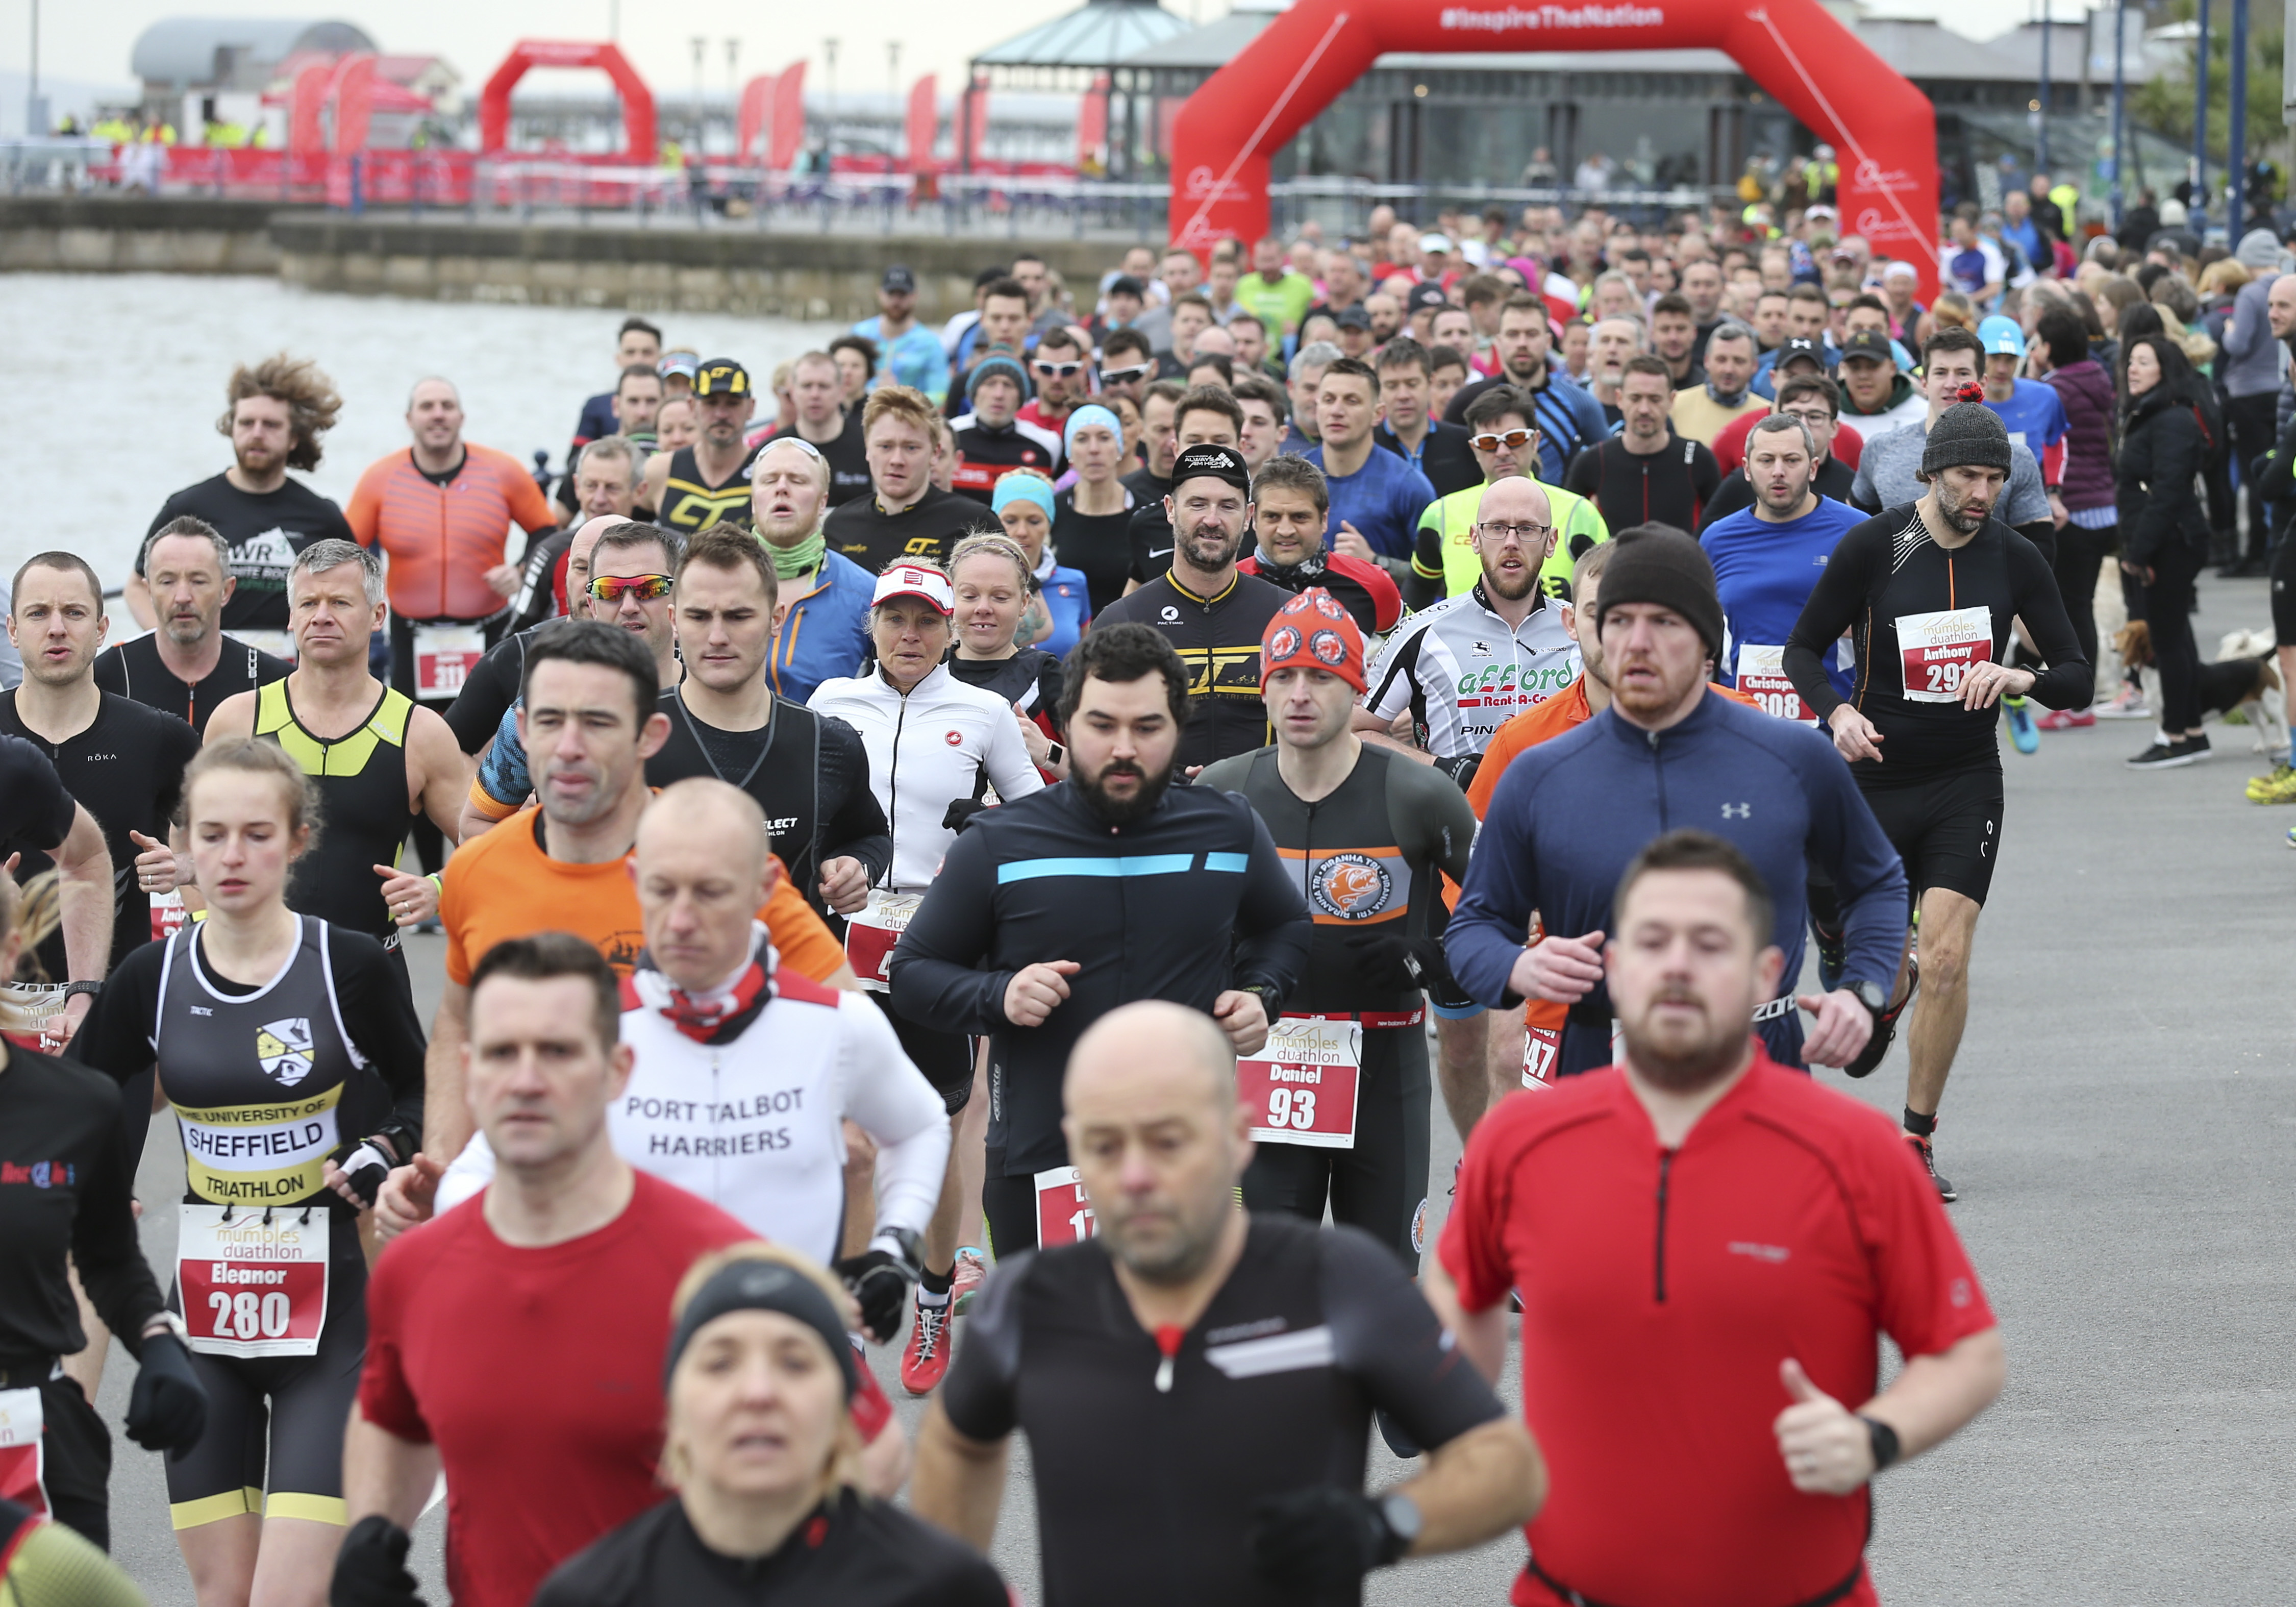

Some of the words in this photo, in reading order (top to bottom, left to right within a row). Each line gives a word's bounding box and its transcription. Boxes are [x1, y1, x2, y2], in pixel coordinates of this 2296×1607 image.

[1440, 3, 1664, 33] #InspireTheNation
[230, 565, 261, 579] HITE
[1923, 616, 1976, 636] mumbles
[1930, 630, 1978, 645] duathlon
[1924, 645, 1973, 662] Anthony
[372, 721, 401, 741] 2XU
[1320, 854, 1364, 872] PIRANHA
[1365, 858, 1381, 871] TRI
[1271, 1029, 1338, 1050] mumbles
[1277, 1048, 1340, 1064] duathlon
[1269, 1064, 1322, 1084] Daniel
[178, 1108, 202, 1121] THE
[204, 1106, 300, 1122] UNIVERSITY
[305, 1099, 327, 1114] OF
[626, 1097, 698, 1122] PORT
[706, 1087, 804, 1123] TALBOT
[1267, 1087, 1316, 1130] 93
[189, 1122, 323, 1157] SHEFFIELD
[649, 1127, 791, 1156] HARRIERS
[206, 1174, 305, 1198] TRIATHLON
[217, 1218, 300, 1243] mumbles
[223, 1242, 303, 1259] duathlon
[211, 1261, 288, 1284] Eleanor
[208, 1290, 291, 1340] 280
